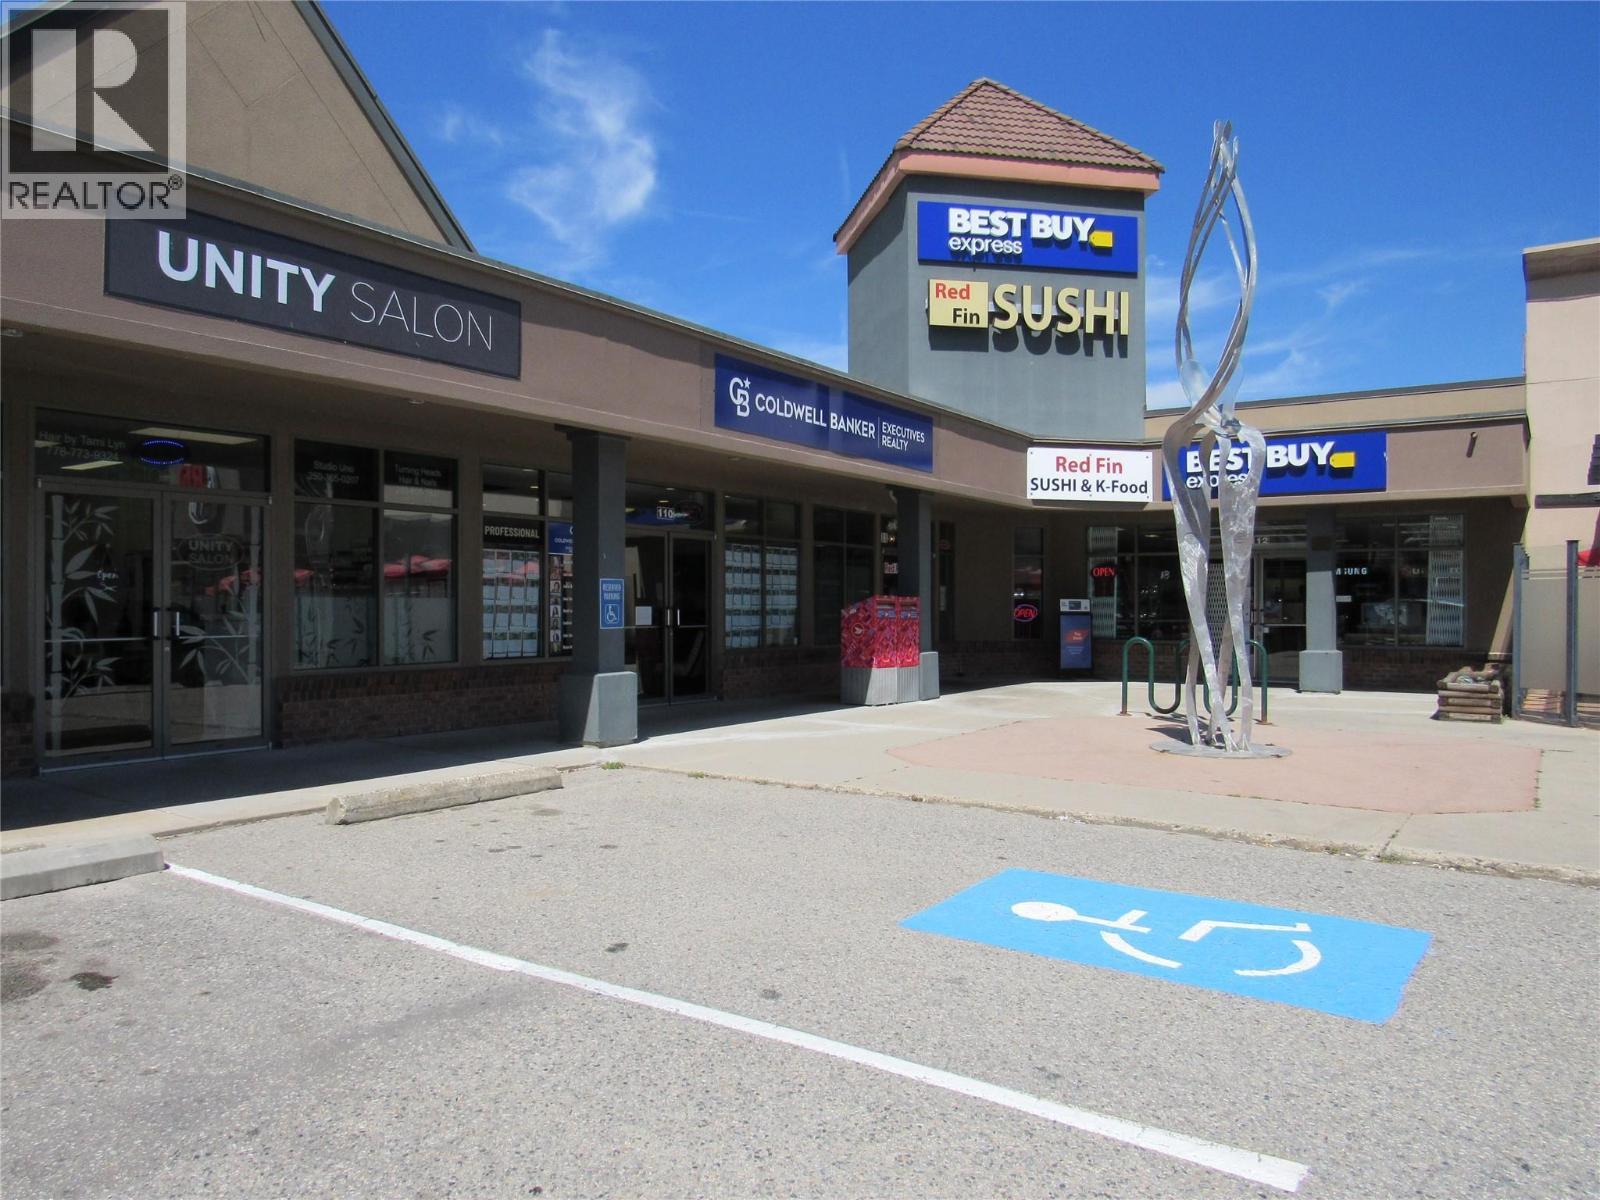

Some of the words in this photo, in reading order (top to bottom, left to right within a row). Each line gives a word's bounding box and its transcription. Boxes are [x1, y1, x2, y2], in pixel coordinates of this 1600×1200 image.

[948, 207, 1027, 237] BEST
[1030, 213, 1096, 241] BUY
[948, 236, 1023, 255] express
[156, 229, 336, 313] UNITY
[350, 281, 493, 351] SALON
[935, 283, 971, 300] Red
[952, 308, 980, 325] Fin
[993, 284, 1129, 336] SUSHI
[755, 393, 827, 428] COLDWELL
[830, 412, 876, 440] BANKER
[882, 421, 925, 443] EXECUTIVES
[881, 435, 909, 451] REALTY
[1266, 442, 1335, 468] BUY
[1056, 456, 1091, 474] Red
[1096, 457, 1123, 475] Fin
[1030, 477, 1077, 493] SUSHI
[1081, 479, 1092, 493] &
[1096, 479, 1148, 494] K-Food
[658, 508, 673, 518] 110
[484, 525, 540, 539] PROFESSIONAL
[188, 540, 233, 552] UNITY
[191, 553, 236, 565] SALON
[1093, 567, 1115, 577] OPEN
[1014, 608, 1036, 619] OPEN
